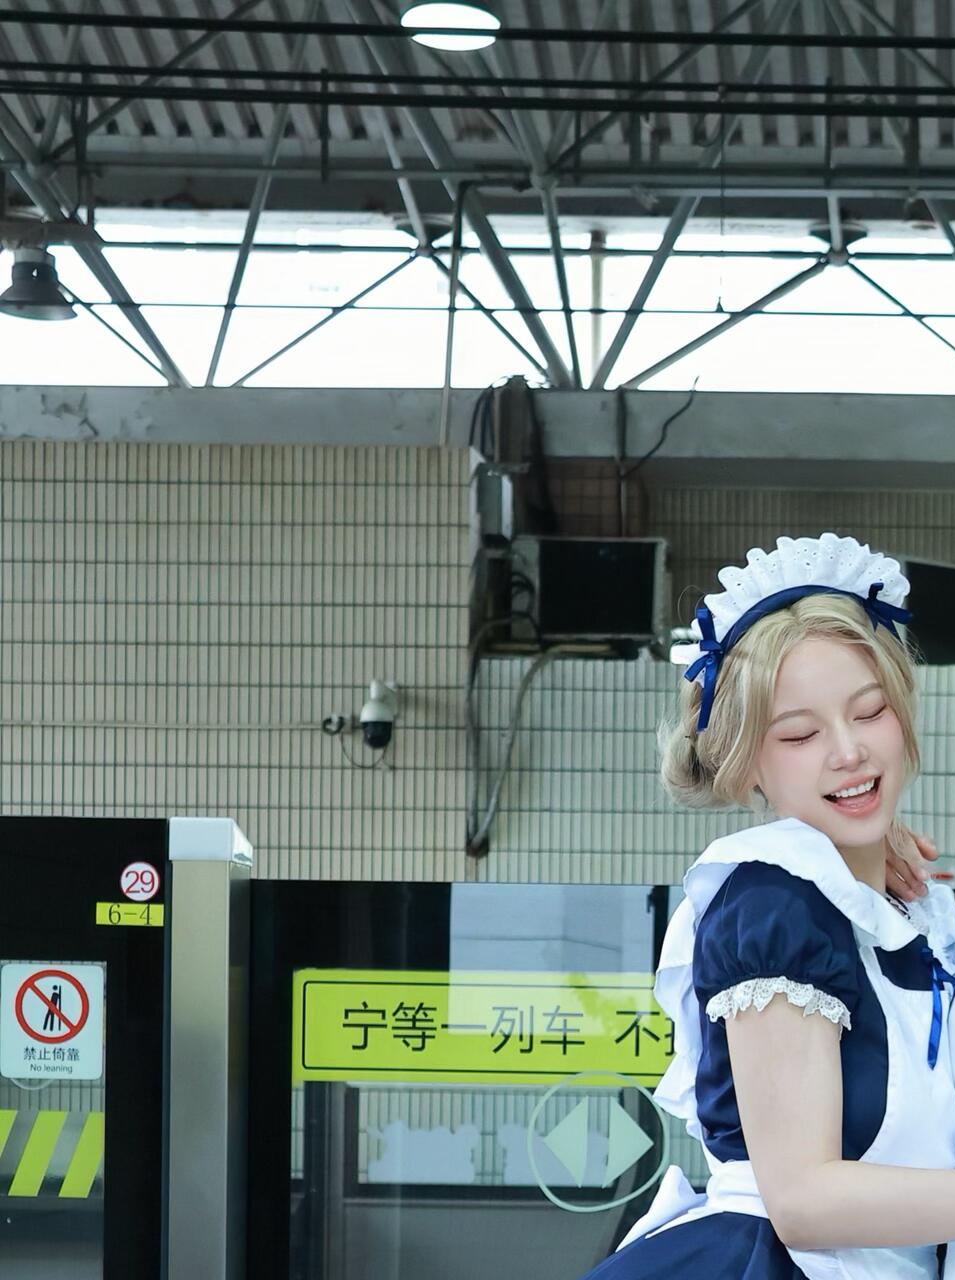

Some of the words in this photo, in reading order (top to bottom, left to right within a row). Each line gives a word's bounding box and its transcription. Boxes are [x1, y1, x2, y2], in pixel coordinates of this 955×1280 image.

[125, 870, 155, 894] 29
[109, 903, 152, 925] 6-4
[342, 1001, 586, 1056] 宁等一列车
[615, 1008, 676, 1057] 不
[24, 1046, 80, 1061] 禁止倚靠
[30, 1063, 42, 1072] No
[44, 1063, 73, 1074] leaning
